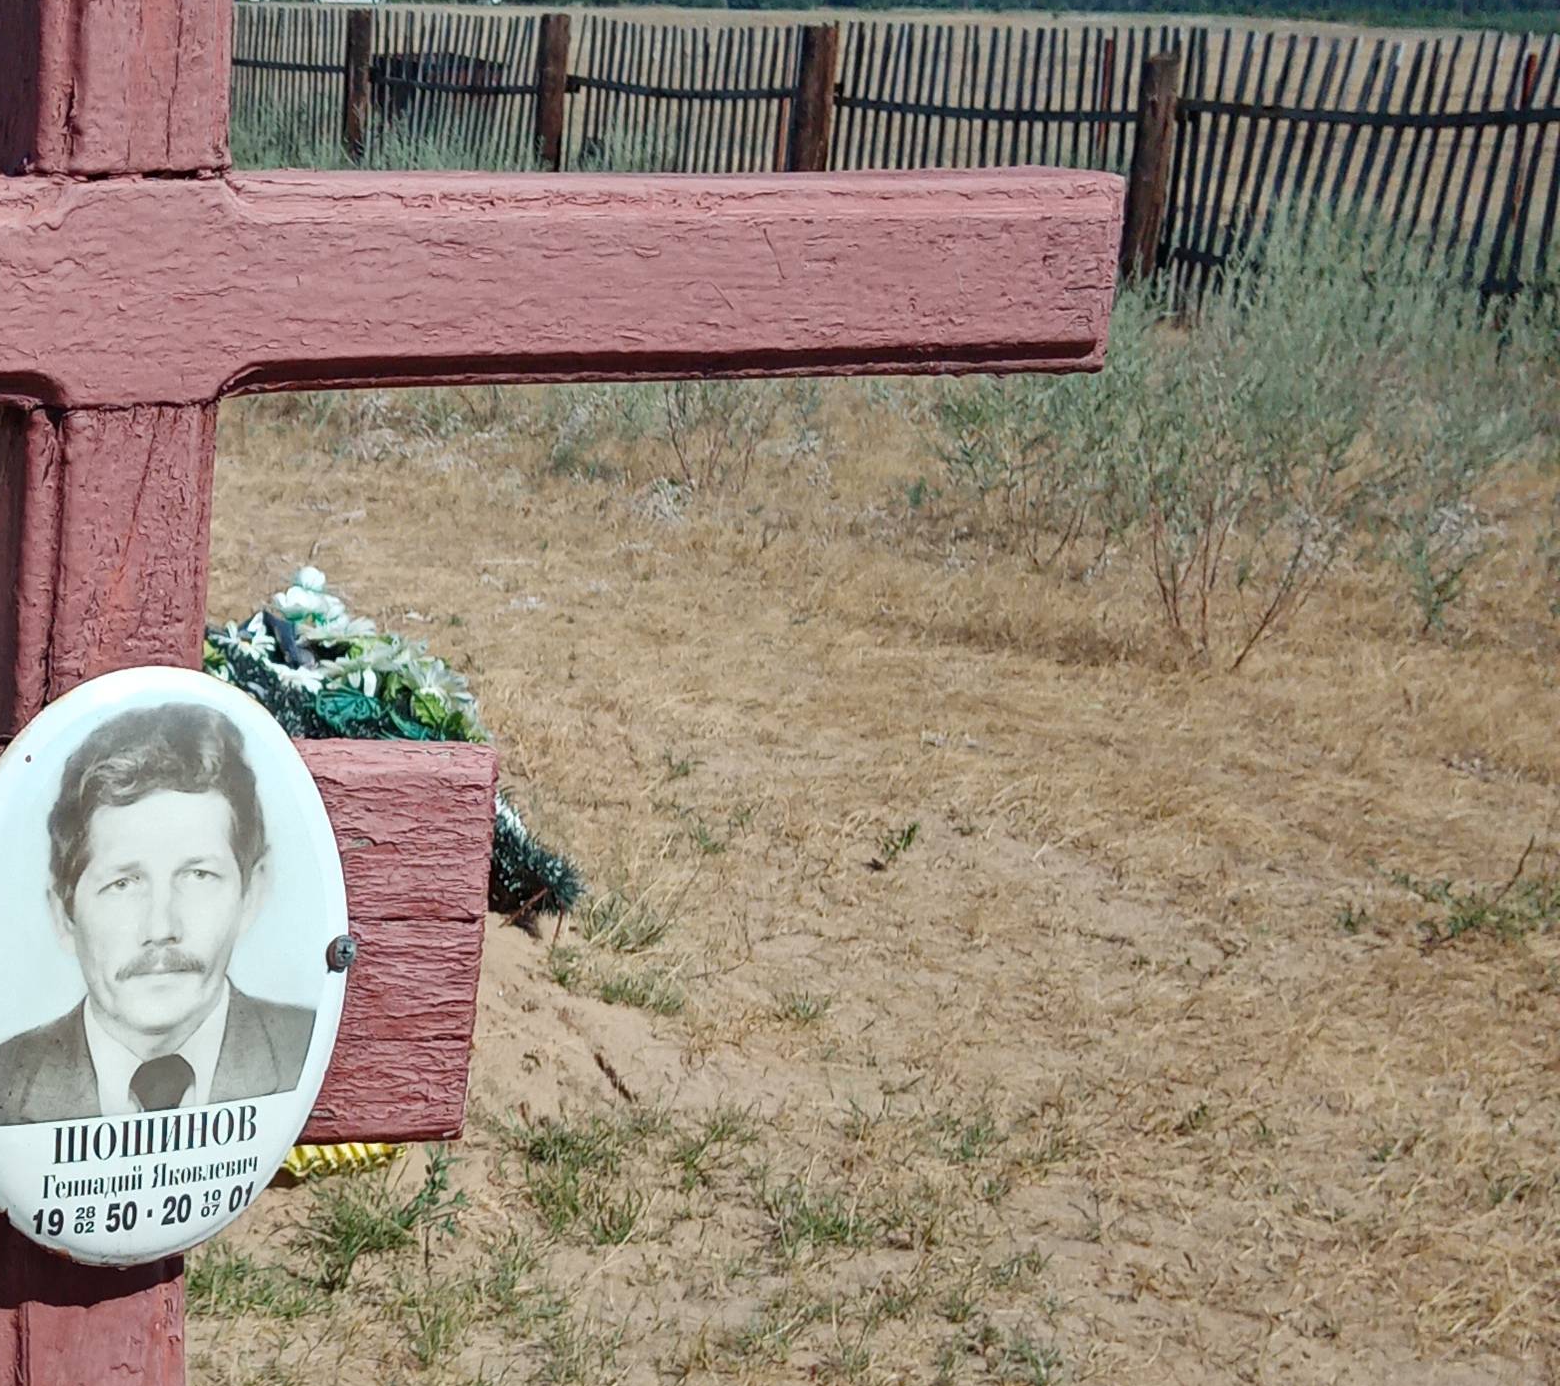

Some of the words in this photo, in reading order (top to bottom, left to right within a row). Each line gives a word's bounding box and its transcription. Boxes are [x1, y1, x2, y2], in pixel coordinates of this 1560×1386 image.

[51, 1104, 258, 1165] ШОШИНОВ
[41, 1164, 144, 1200] Геннадий
[151, 1155, 259, 1189] Яковлевич
[32, 1207, 65, 1237] 19
[74, 1205, 96, 1220] 28
[104, 1200, 139, 1234] 50
[160, 1193, 192, 1226] 20
[202, 1189, 222, 1204] 10
[228, 1180, 255, 1213] 01
[73, 1221, 96, 1235] 02
[200, 1203, 220, 1218] 07
